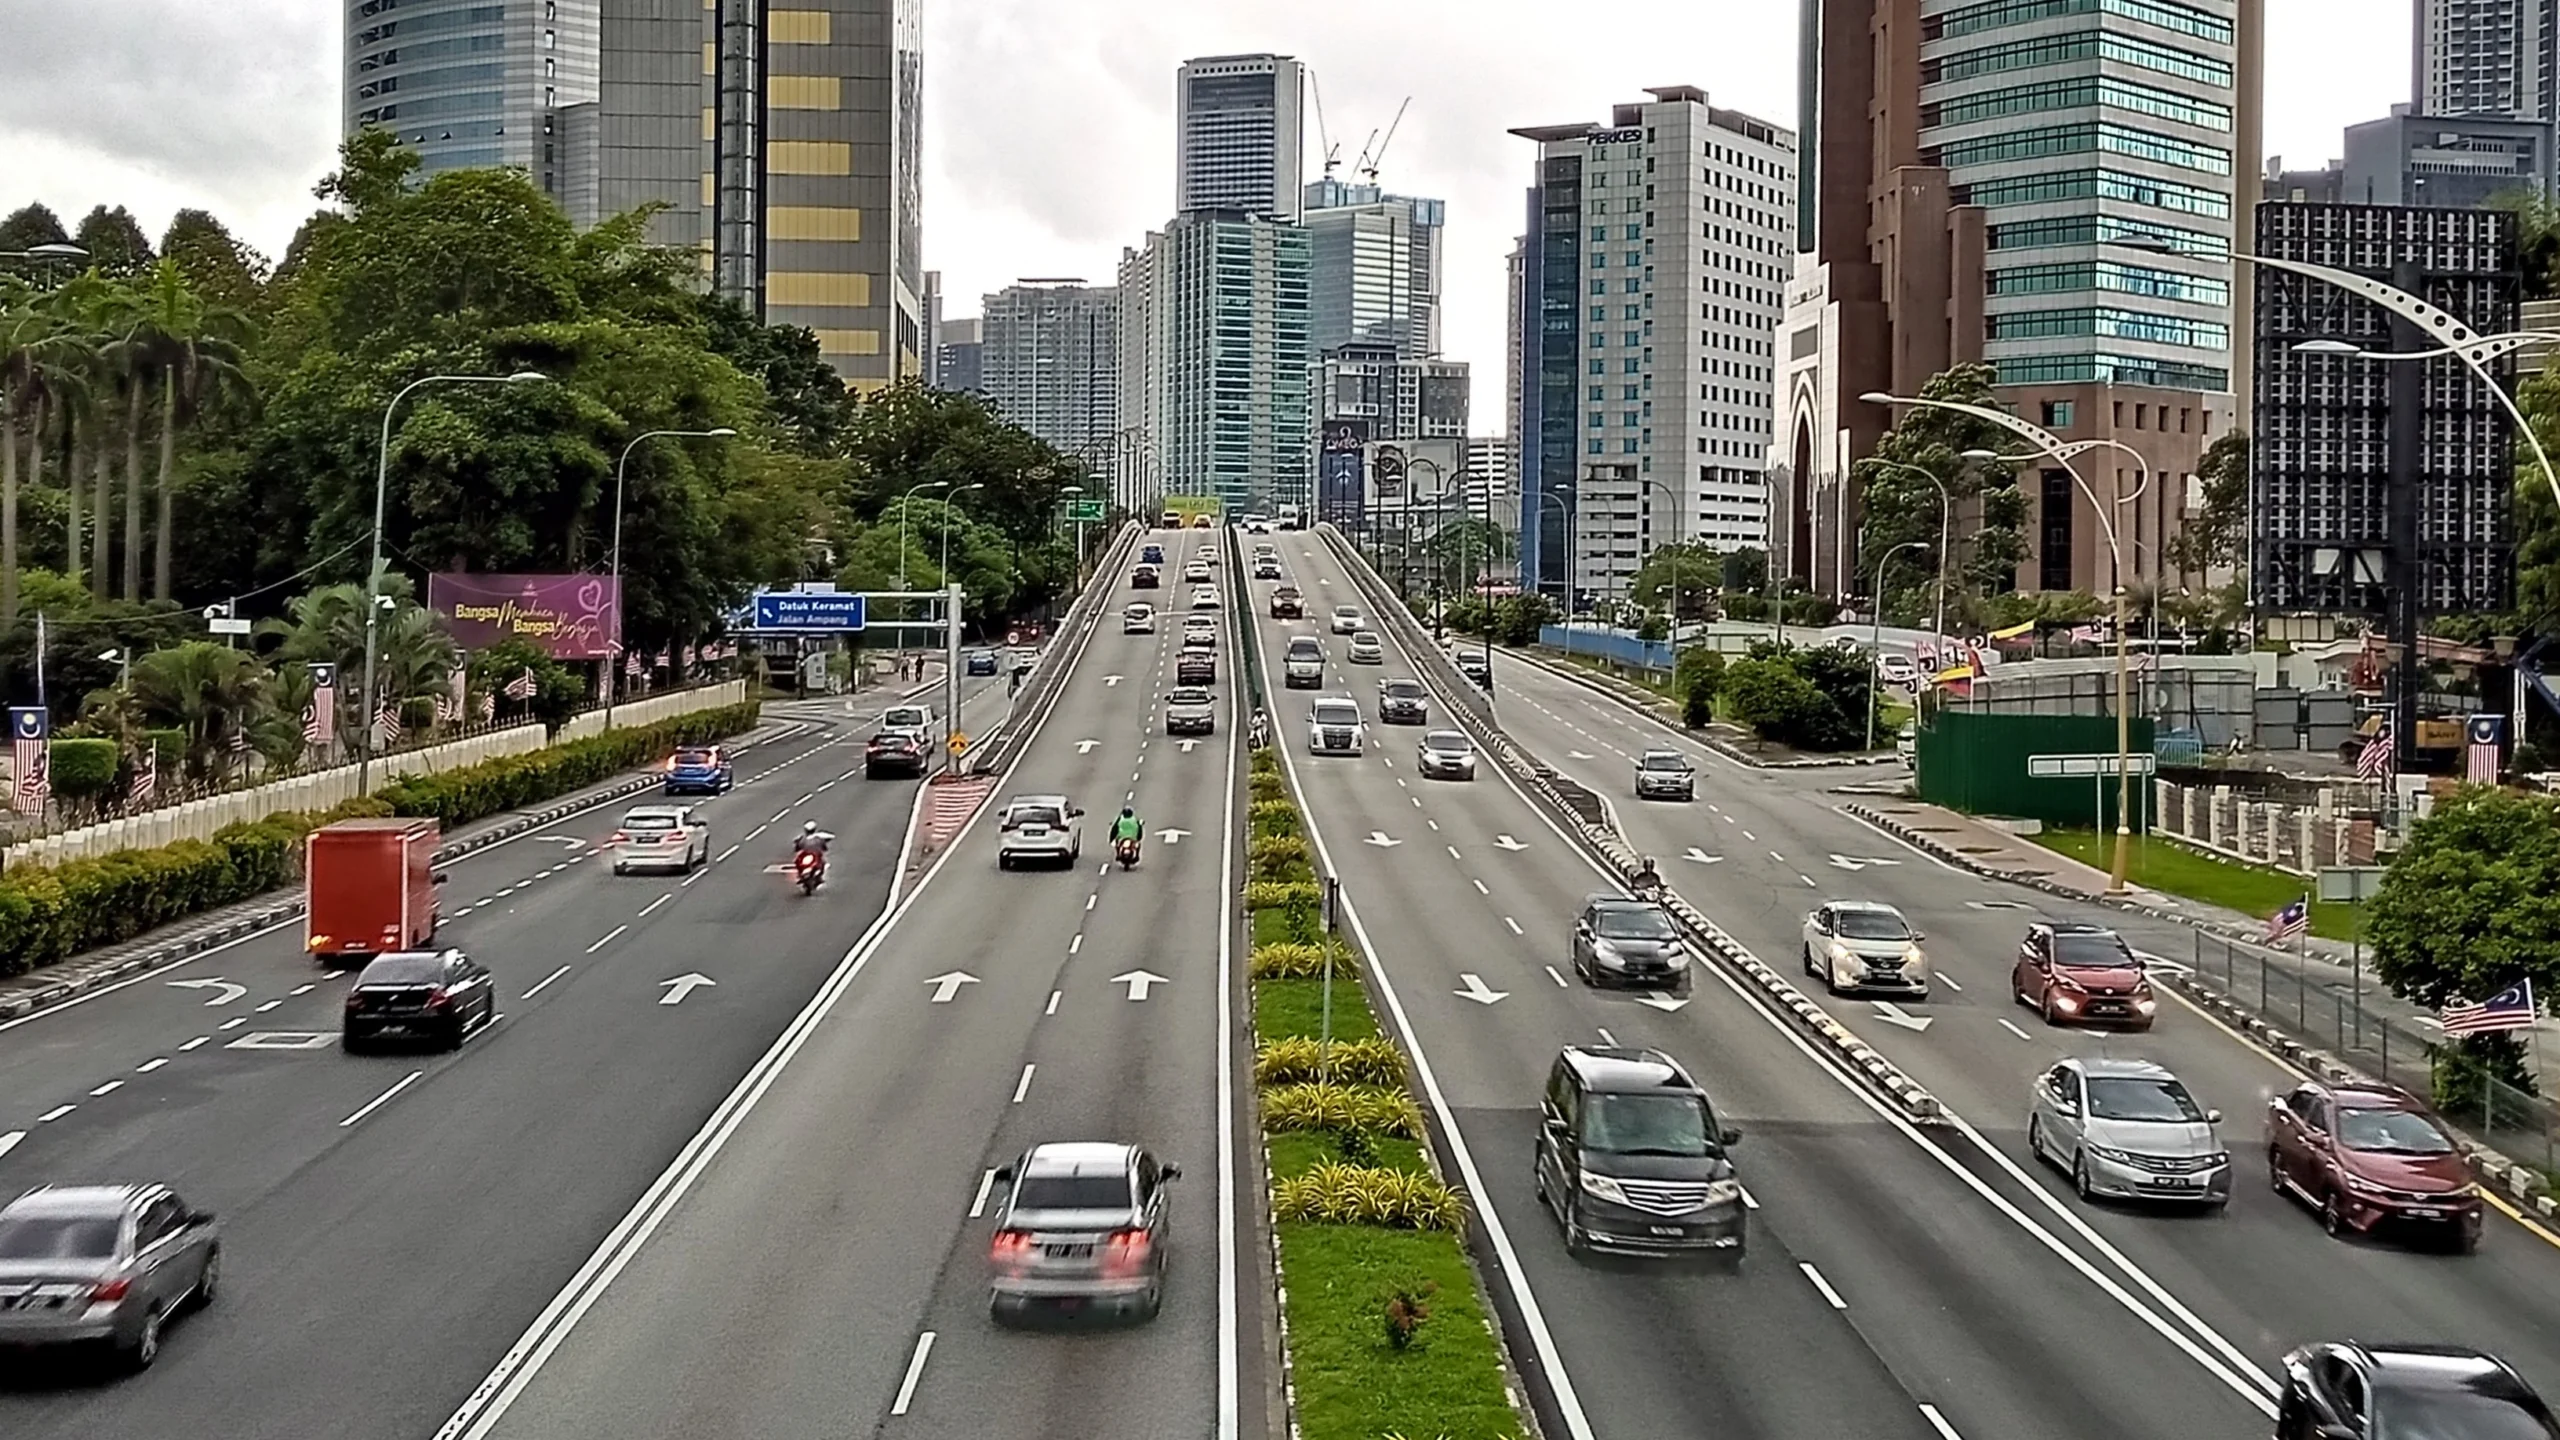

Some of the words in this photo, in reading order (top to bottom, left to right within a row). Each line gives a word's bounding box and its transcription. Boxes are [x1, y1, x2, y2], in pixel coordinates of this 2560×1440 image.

[455, 604, 499, 621] Bangsa
[779, 601, 809, 611] Datuk
[812, 601, 855, 611] Keramat
[777, 614, 804, 624] Jalan
[807, 614, 848, 625] Ampang
[513, 619, 555, 636] Bangsa
